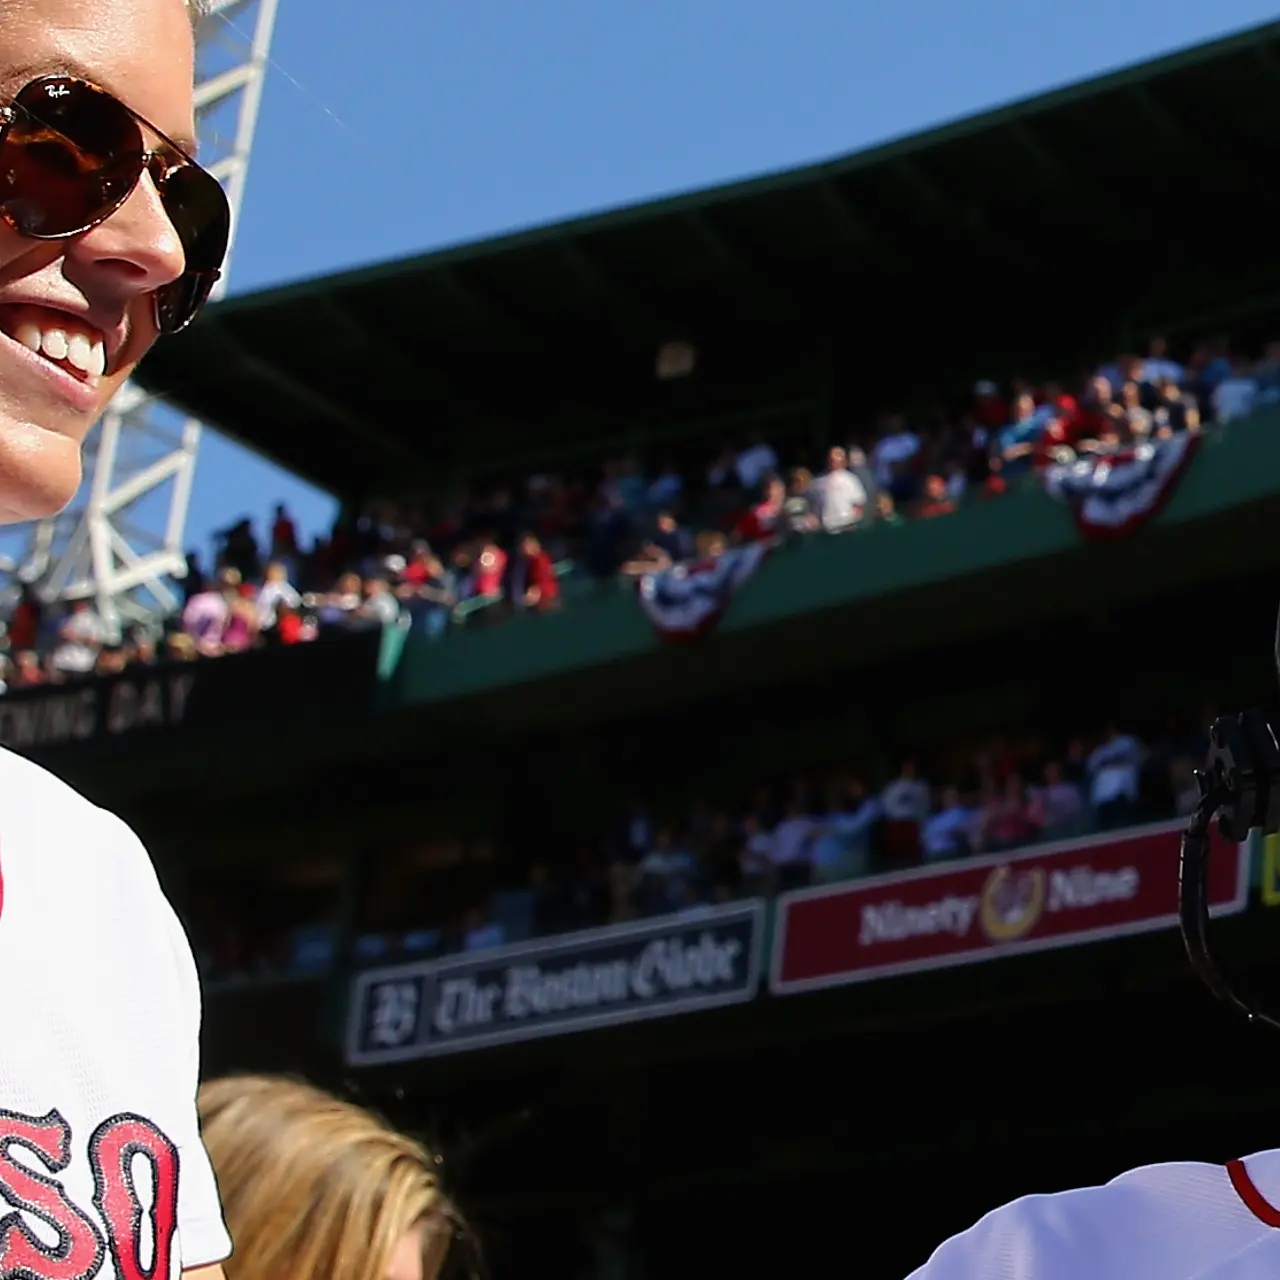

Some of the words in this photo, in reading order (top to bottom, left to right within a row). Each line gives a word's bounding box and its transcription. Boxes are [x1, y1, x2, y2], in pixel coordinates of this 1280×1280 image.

[107, 674, 195, 733] DAY
[858, 892, 980, 946] Ninety
[1047, 865, 1141, 912] Nine
[436, 978, 500, 1032] The
[505, 960, 629, 1018] Boston
[633, 933, 741, 997] Globe
